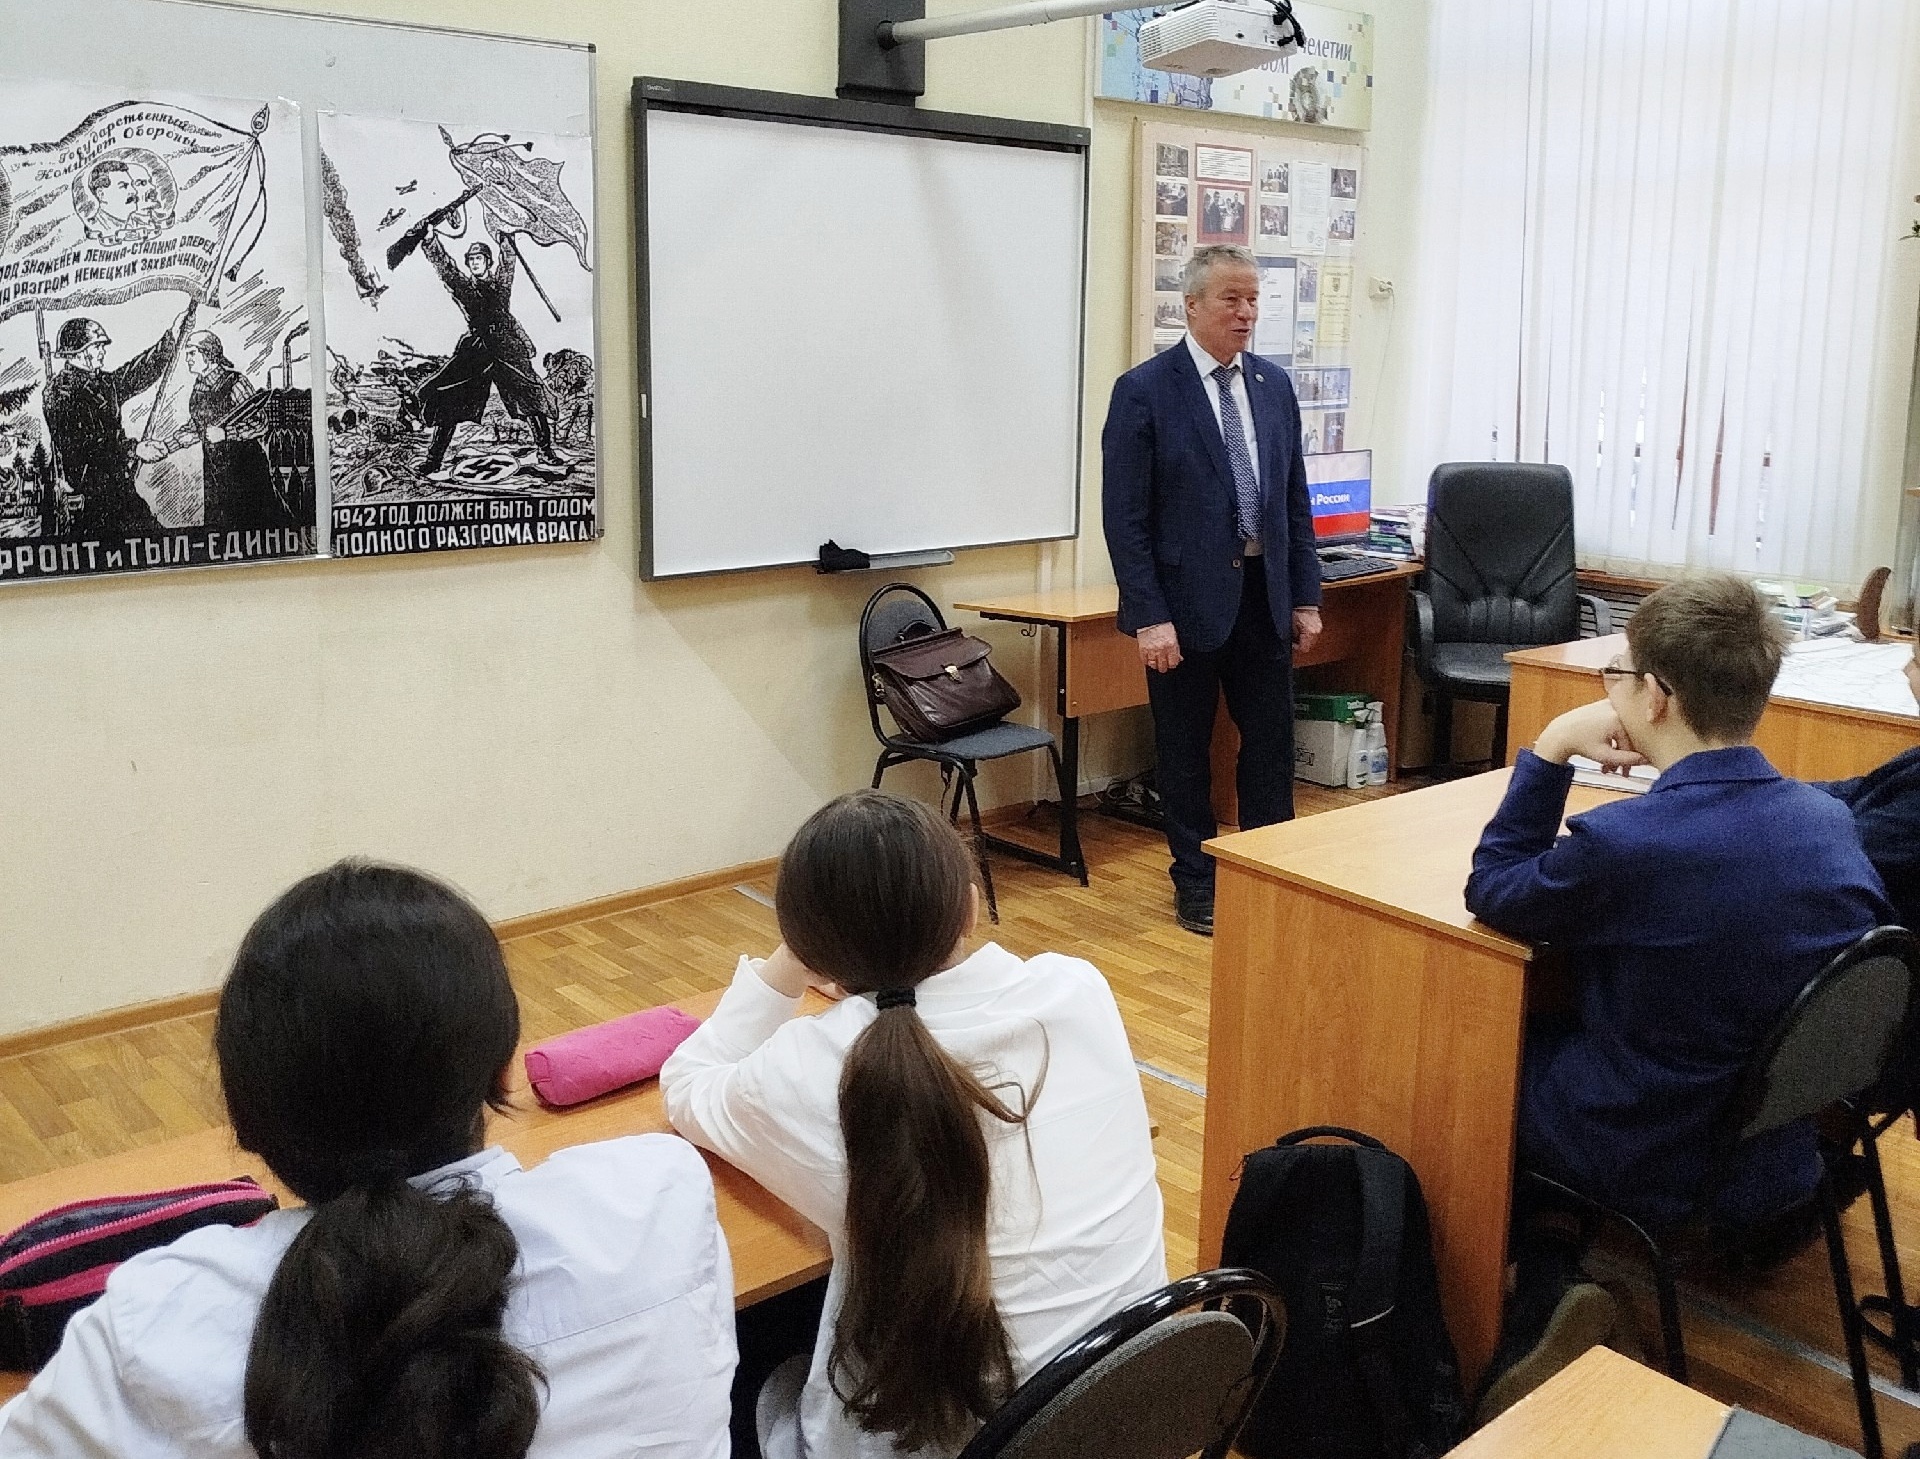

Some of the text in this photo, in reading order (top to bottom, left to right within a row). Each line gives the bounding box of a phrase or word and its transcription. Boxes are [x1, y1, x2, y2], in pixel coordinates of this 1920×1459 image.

[34, 123, 198, 181] Комитет Обороны
[21, 250, 81, 275] ЗНАМЕНЕМ
[0, 286, 10, 305] А
[13, 273, 70, 299] РАЗГРОМ
[74, 258, 138, 284] НЕМЕЦКИХ
[332, 498, 596, 529] 1942 ГОД ДОЛЖЕН БЫТЬ ГОДОМ
[1316, 493, 1350, 506] России
[336, 527, 430, 557] ПОЛНОГО
[435, 521, 535, 547] РАЗГРОМА
